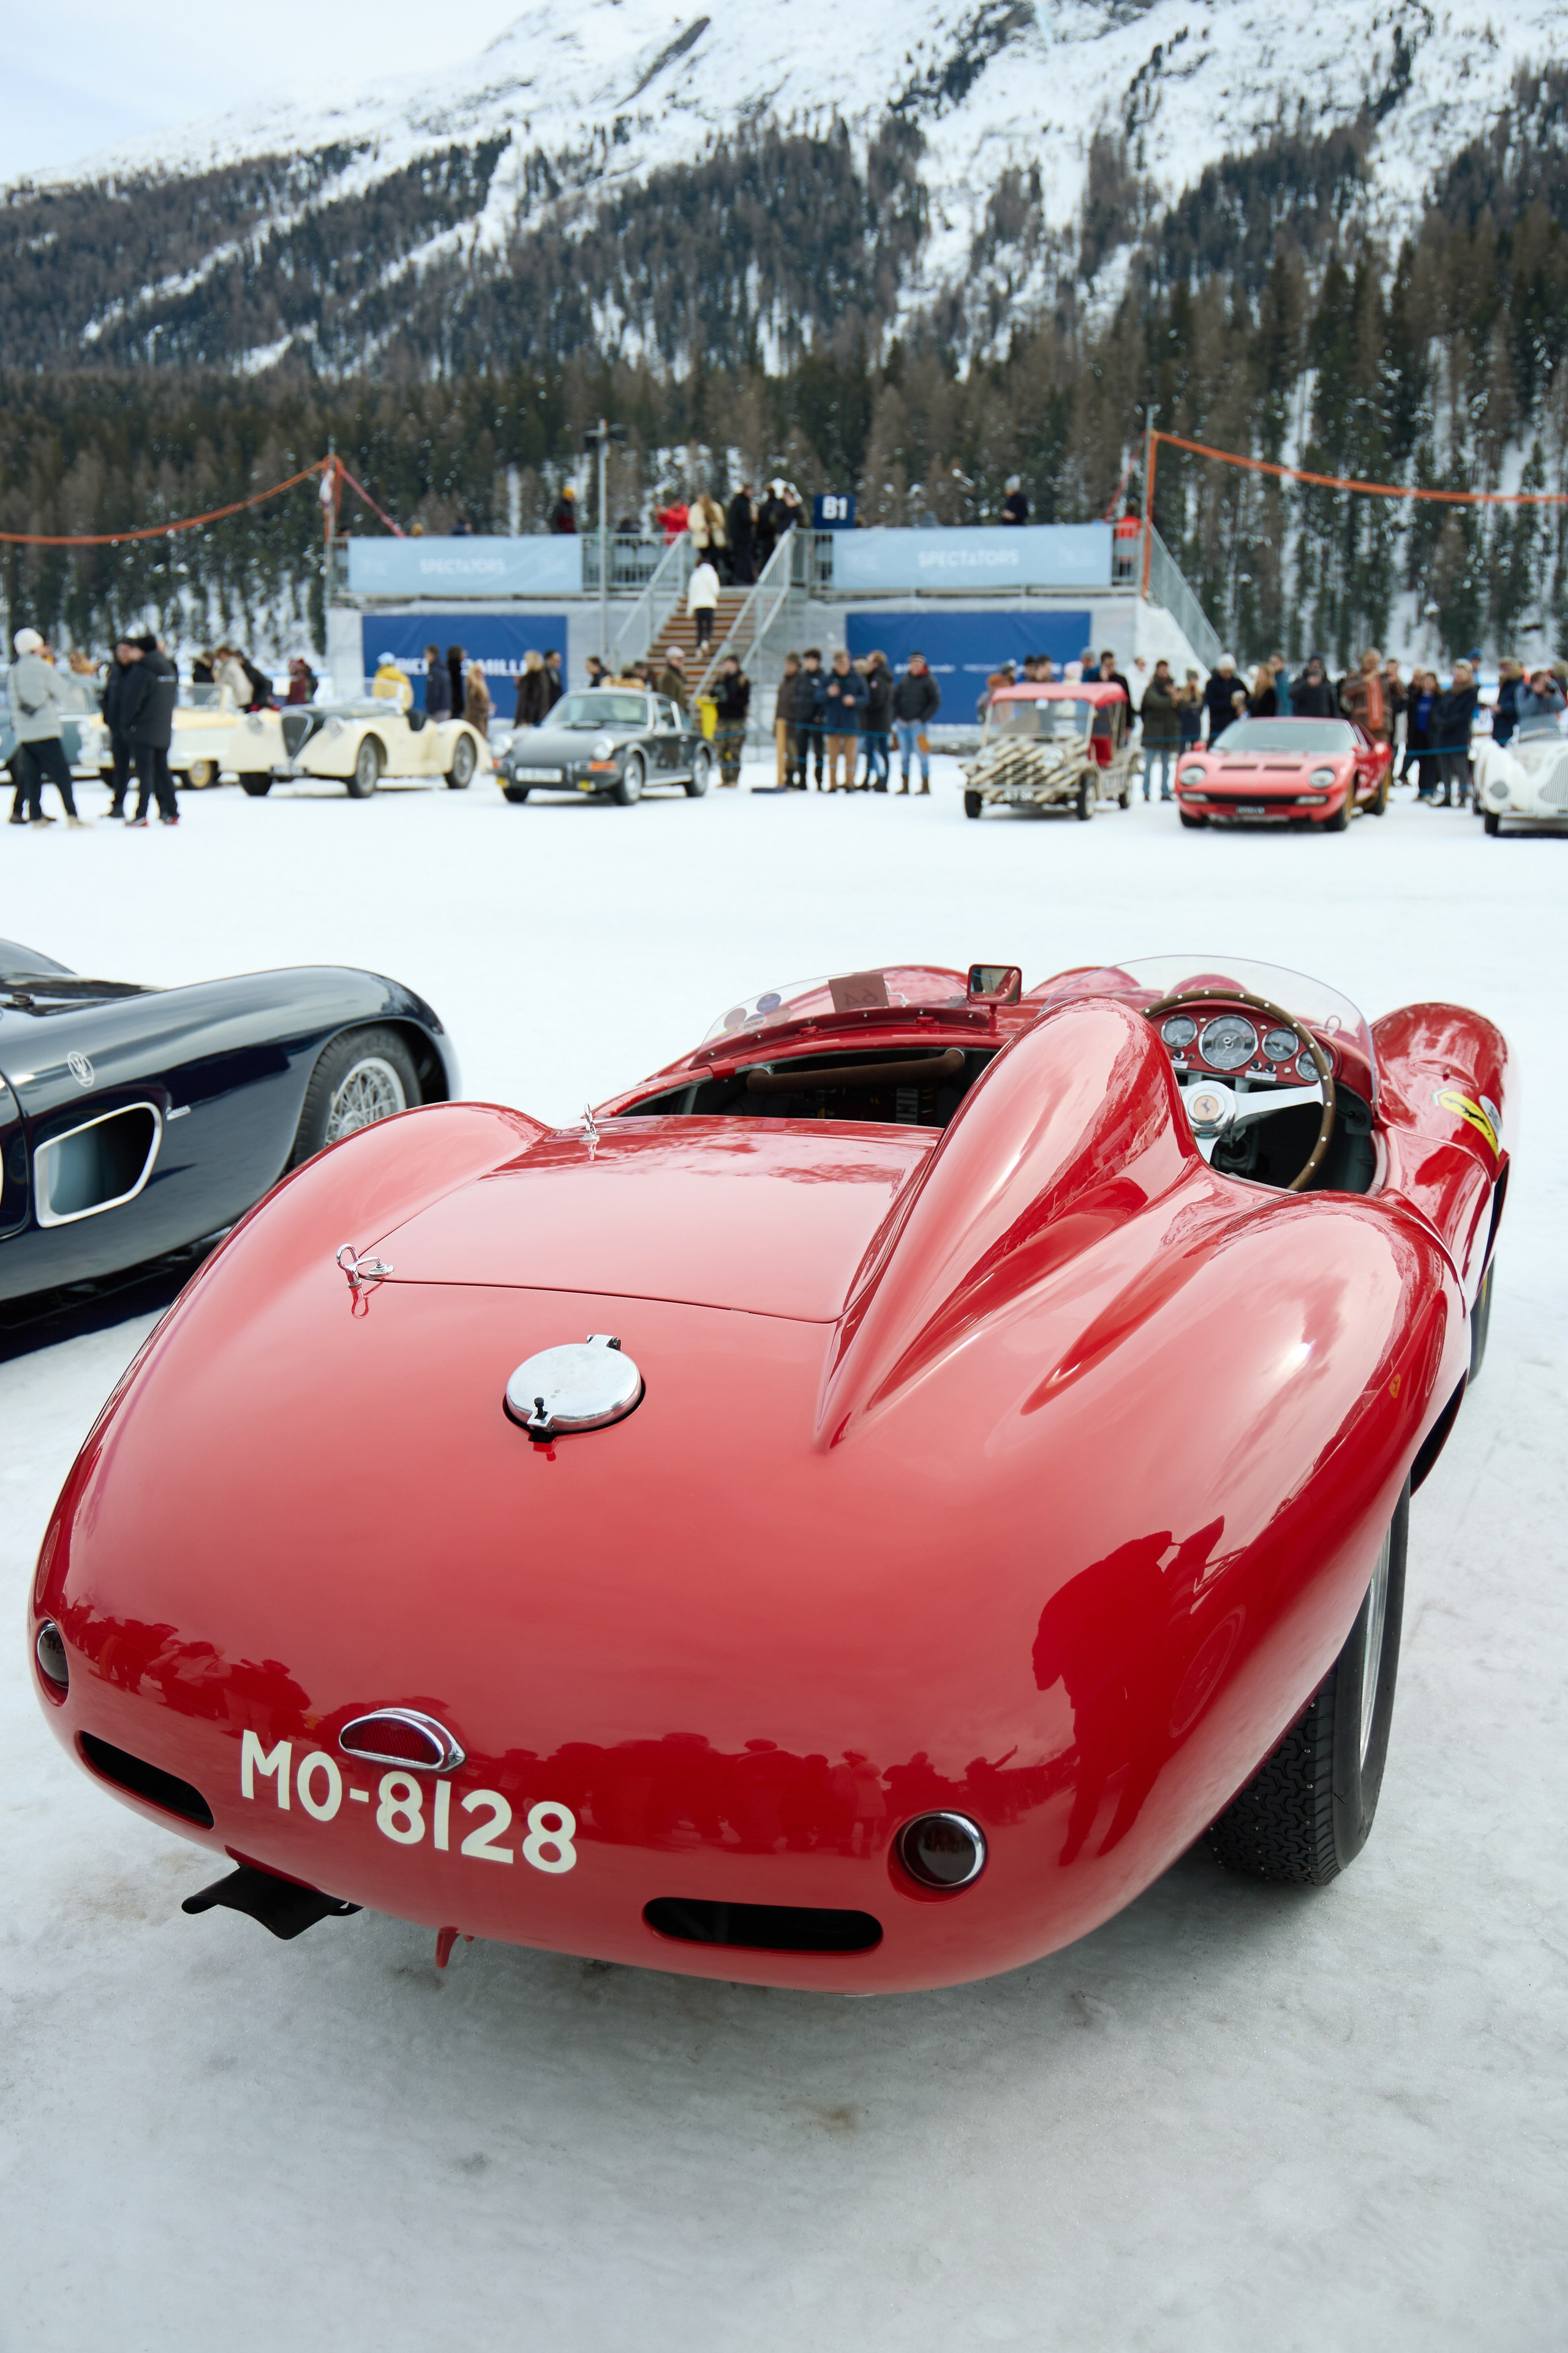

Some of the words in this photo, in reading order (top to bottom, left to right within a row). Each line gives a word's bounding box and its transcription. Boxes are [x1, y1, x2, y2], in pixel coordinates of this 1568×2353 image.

[822, 496, 848, 521] B1
[421, 559, 505, 573] SPECTATORS
[919, 550, 1019, 567] SPECTATORS
[241, 1729, 576, 1873] MO-8128
